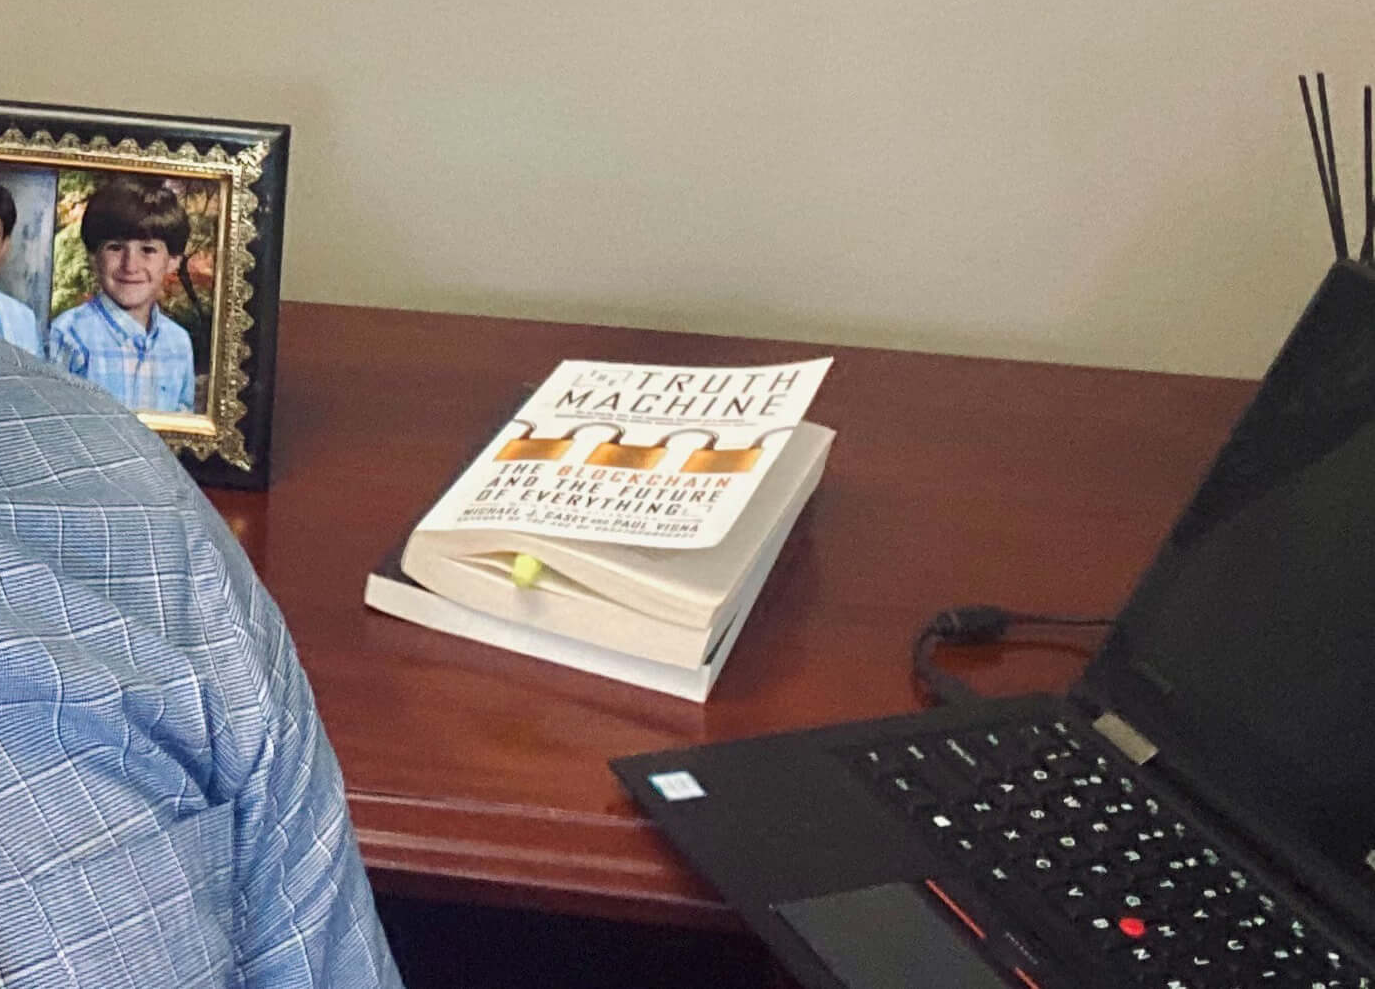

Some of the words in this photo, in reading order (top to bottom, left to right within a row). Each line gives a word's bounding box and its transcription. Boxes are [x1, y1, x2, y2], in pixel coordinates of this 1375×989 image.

[636, 370, 801, 393] TRUTH
[554, 389, 788, 417] MACHINE
[499, 463, 544, 475] THE
[556, 466, 732, 488] BLOCKCHAIN
[475, 488, 508, 501] OF
[520, 489, 682, 516] EVERYTHING
[486, 476, 537, 488] AND
[556, 479, 602, 493] THE
[619, 485, 723, 503] FUTURE
[463, 507, 521, 516] MICHAEL
[544, 511, 588, 523] CASEY
[613, 518, 647, 529] PAUL
